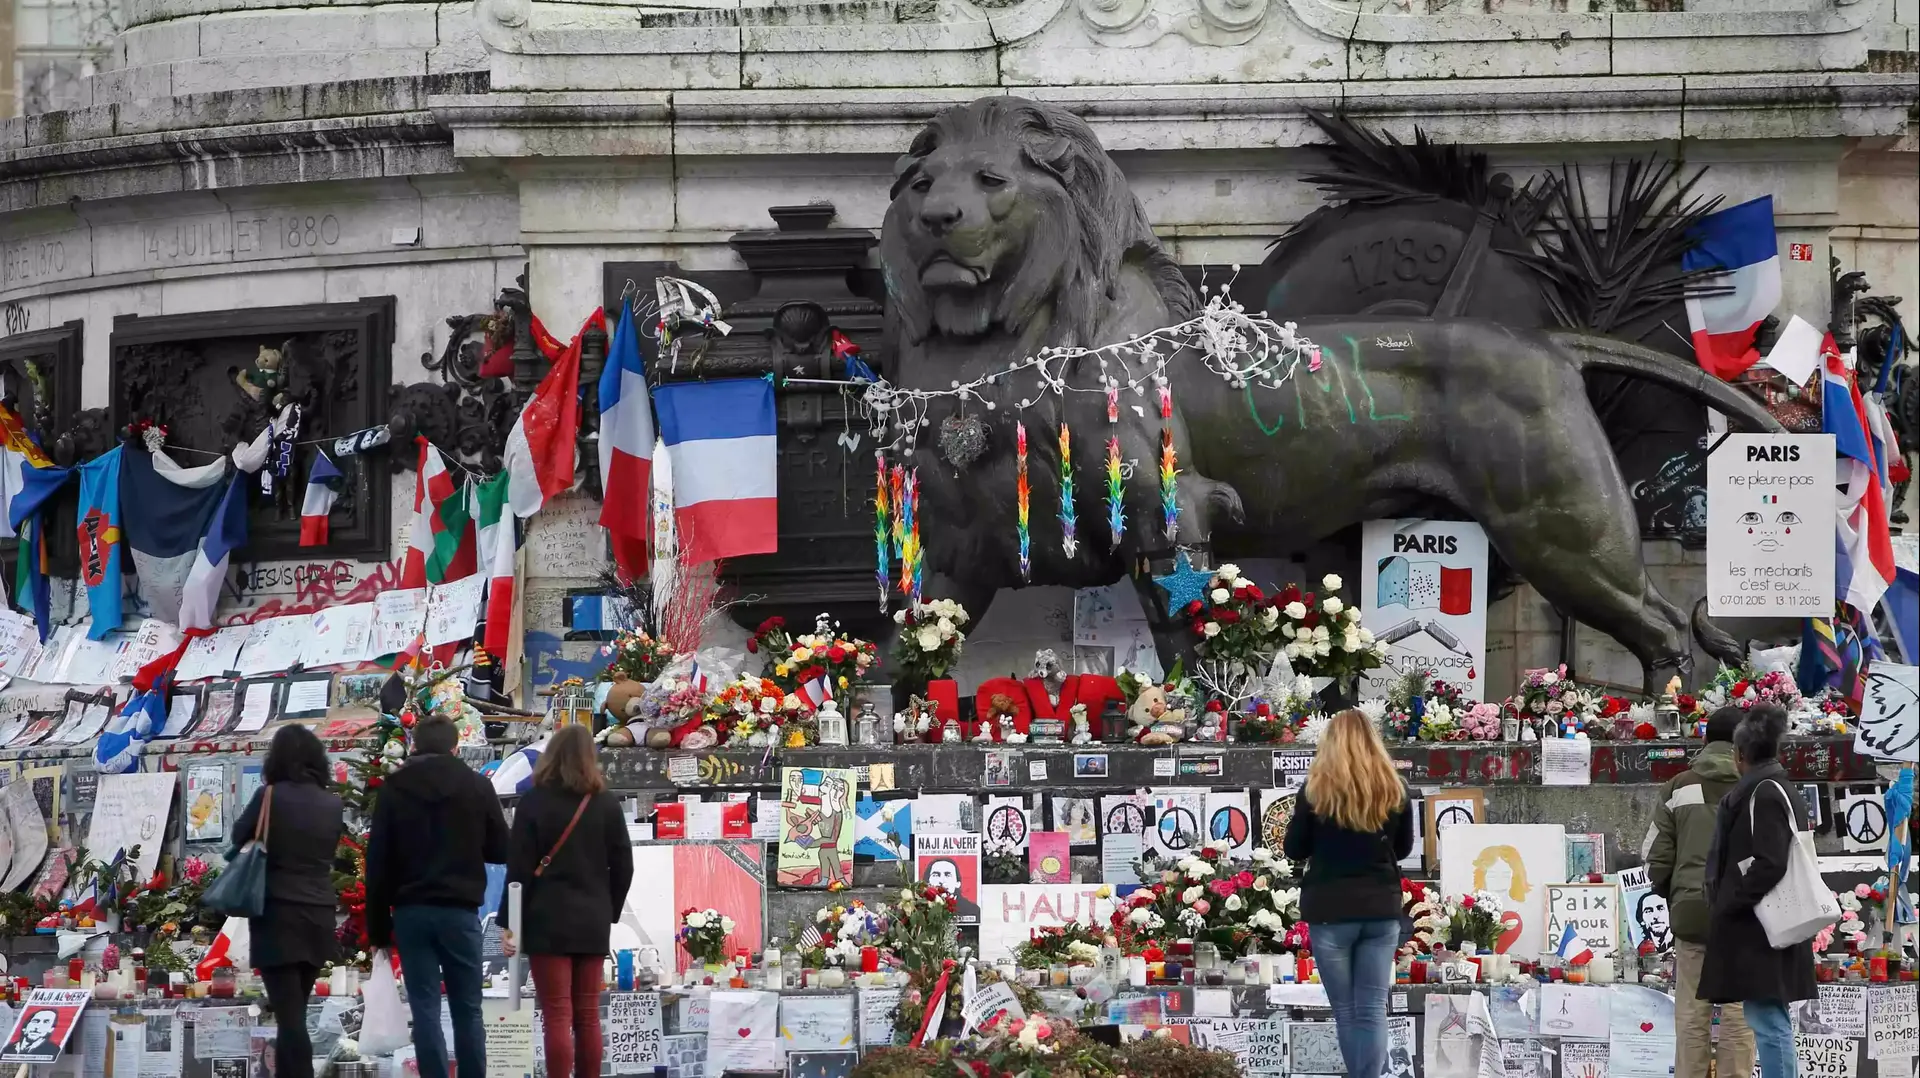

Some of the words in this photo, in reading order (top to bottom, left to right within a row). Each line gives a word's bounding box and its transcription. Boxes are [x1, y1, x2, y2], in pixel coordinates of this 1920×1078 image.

[142, 228, 160, 262] 14
[168, 216, 268, 260] JUILLET
[280, 213, 341, 249] 1880
[1341, 237, 1452, 295] 1789
[1746, 445, 1801, 462] PARIS
[1728, 475, 1746, 486] ne
[1748, 470, 1787, 490] pleure
[1789, 475, 1815, 490] pas
[1393, 533, 1458, 555] PARIS
[1729, 561, 1747, 577] les
[1401, 654, 1473, 668] mauvaise
[928, 673, 1126, 744] LOVE
[918, 837, 939, 850] NAJI
[943, 837, 954, 850] AL
[956, 837, 978, 850] JERF
[1622, 870, 1646, 888] NAJI
[1549, 888, 1607, 912] Paix
[32, 991, 53, 1001] NAJI
[1213, 1022, 1228, 1031] LA
[1233, 1021, 1278, 1032] VERITE
[1873, 1014, 1912, 1024] AURONT
[612, 1029, 660, 1043] BOMBES
[1795, 1036, 1853, 1052] SAUVONS
[612, 1044, 638, 1053] STOP
[644, 1043, 658, 1052] LA
[1806, 1061, 1847, 1074] STOP
